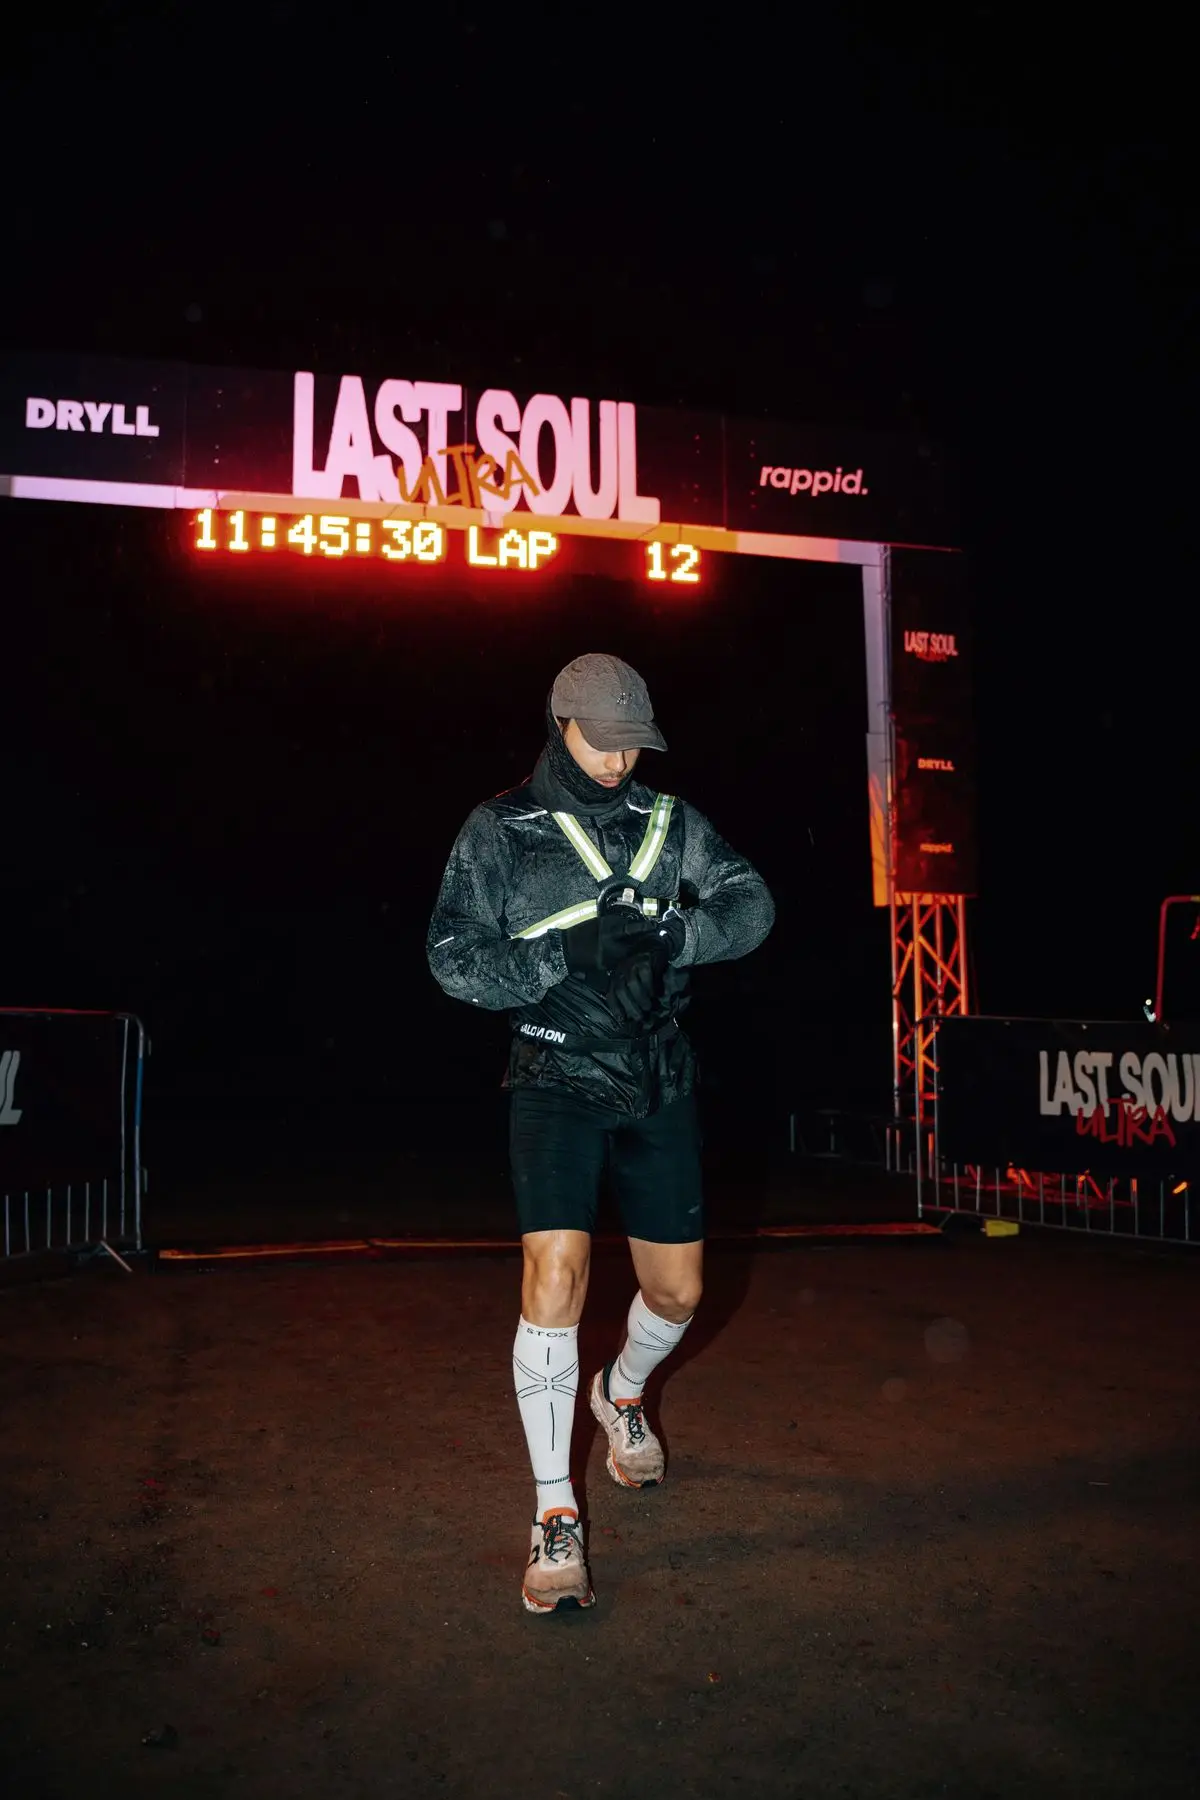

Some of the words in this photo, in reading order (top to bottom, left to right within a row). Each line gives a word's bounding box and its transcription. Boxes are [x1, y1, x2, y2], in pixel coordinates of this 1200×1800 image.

[26, 397, 159, 438] DRYLL
[293, 371, 462, 506] LAST
[475, 388, 661, 528] SOUL
[397, 443, 541, 510] ULTRA
[759, 465, 869, 497] rappid.
[196, 508, 443, 562] 11:45:30
[468, 526, 557, 570] LAP
[646, 542, 701, 580] 12
[904, 630, 929, 652] LAST
[930, 632, 959, 656] SOUL
[1039, 1050, 1114, 1118] LAST
[1075, 1098, 1177, 1148] ULTRA
[526, 1327, 569, 1338] STOX
